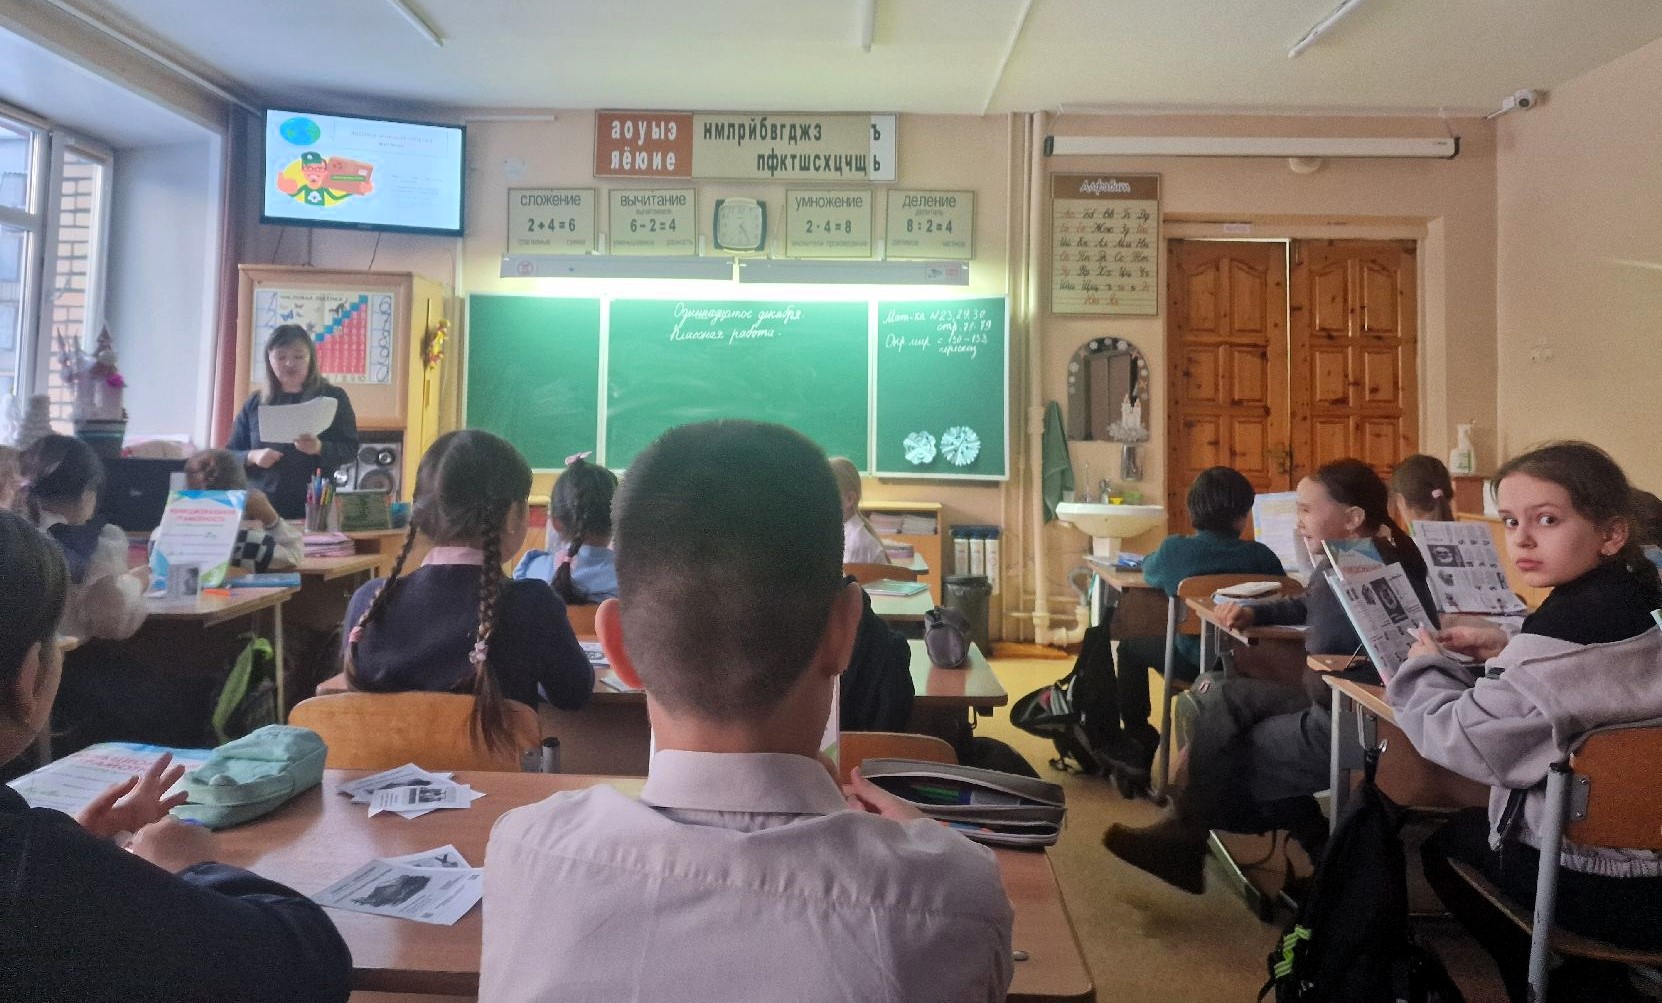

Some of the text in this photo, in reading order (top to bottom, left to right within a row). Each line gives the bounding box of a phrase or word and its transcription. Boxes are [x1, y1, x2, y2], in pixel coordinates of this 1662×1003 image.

[520, 194, 581, 206] сложение
[620, 194, 687, 207] вычитание
[795, 195, 863, 211] умножение
[902, 194, 957, 208] деление
